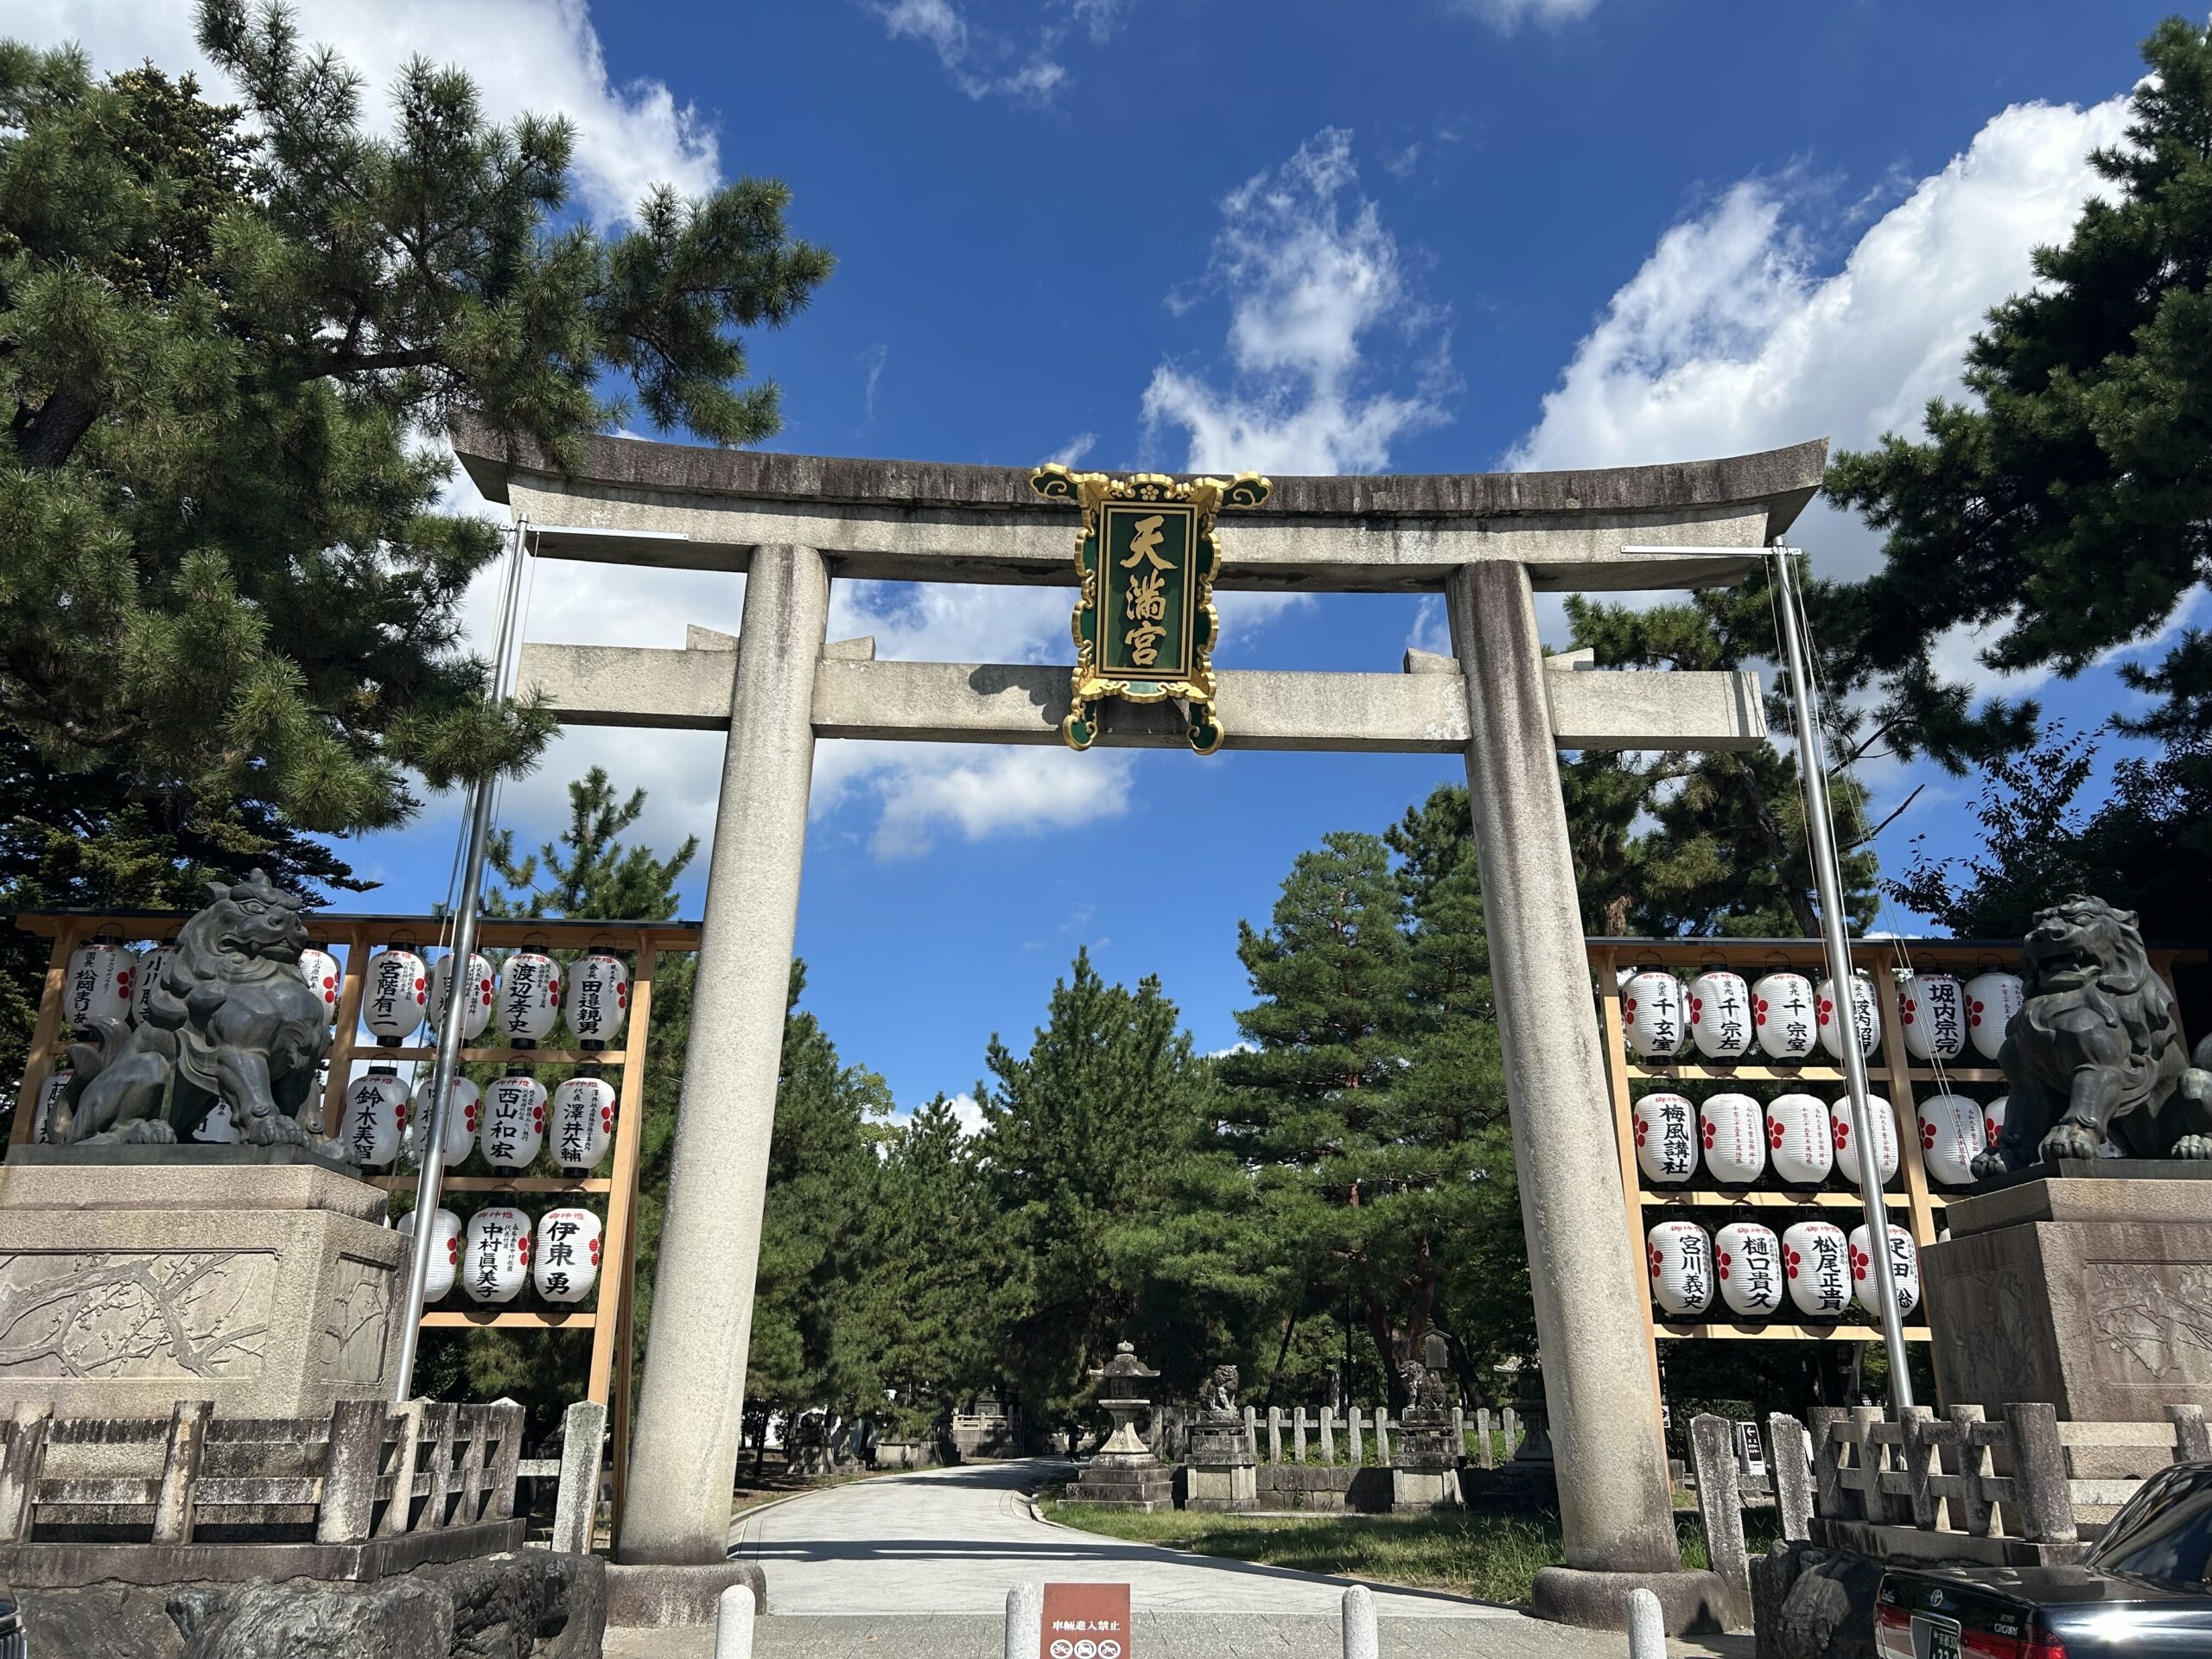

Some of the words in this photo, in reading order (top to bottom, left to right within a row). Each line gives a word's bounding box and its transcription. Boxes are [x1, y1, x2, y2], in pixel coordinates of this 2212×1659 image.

[372, 961, 404, 1026] 宮階有二
[505, 963, 537, 1033] 渡辺孝史
[587, 963, 599, 979] 会長
[1788, 981, 1800, 996] 家元
[1651, 997, 1675, 1052] 千玄室
[1716, 997, 1743, 1050] 千宗左
[1783, 998, 1808, 1052] 千宗室
[1928, 983, 1959, 1054] 堀内宗完
[353, 1086, 385, 1160] 鈴木美智
[489, 1089, 522, 1160] 西山和宏
[573, 1088, 583, 1102] 代表
[560, 1103, 585, 1162] 澤井大輔
[1659, 1104, 1690, 1174] 梅風講社
[476, 1223, 503, 1298] 中村眞美子
[544, 1220, 581, 1295] 伊東勇
[1677, 1235, 1705, 1309] 宮川義史
[1742, 1236, 1774, 1308] 樋口貴久
[1812, 1236, 1844, 1311] 松尾正貴
[1994, 1624, 2018, 1636] CROWN
